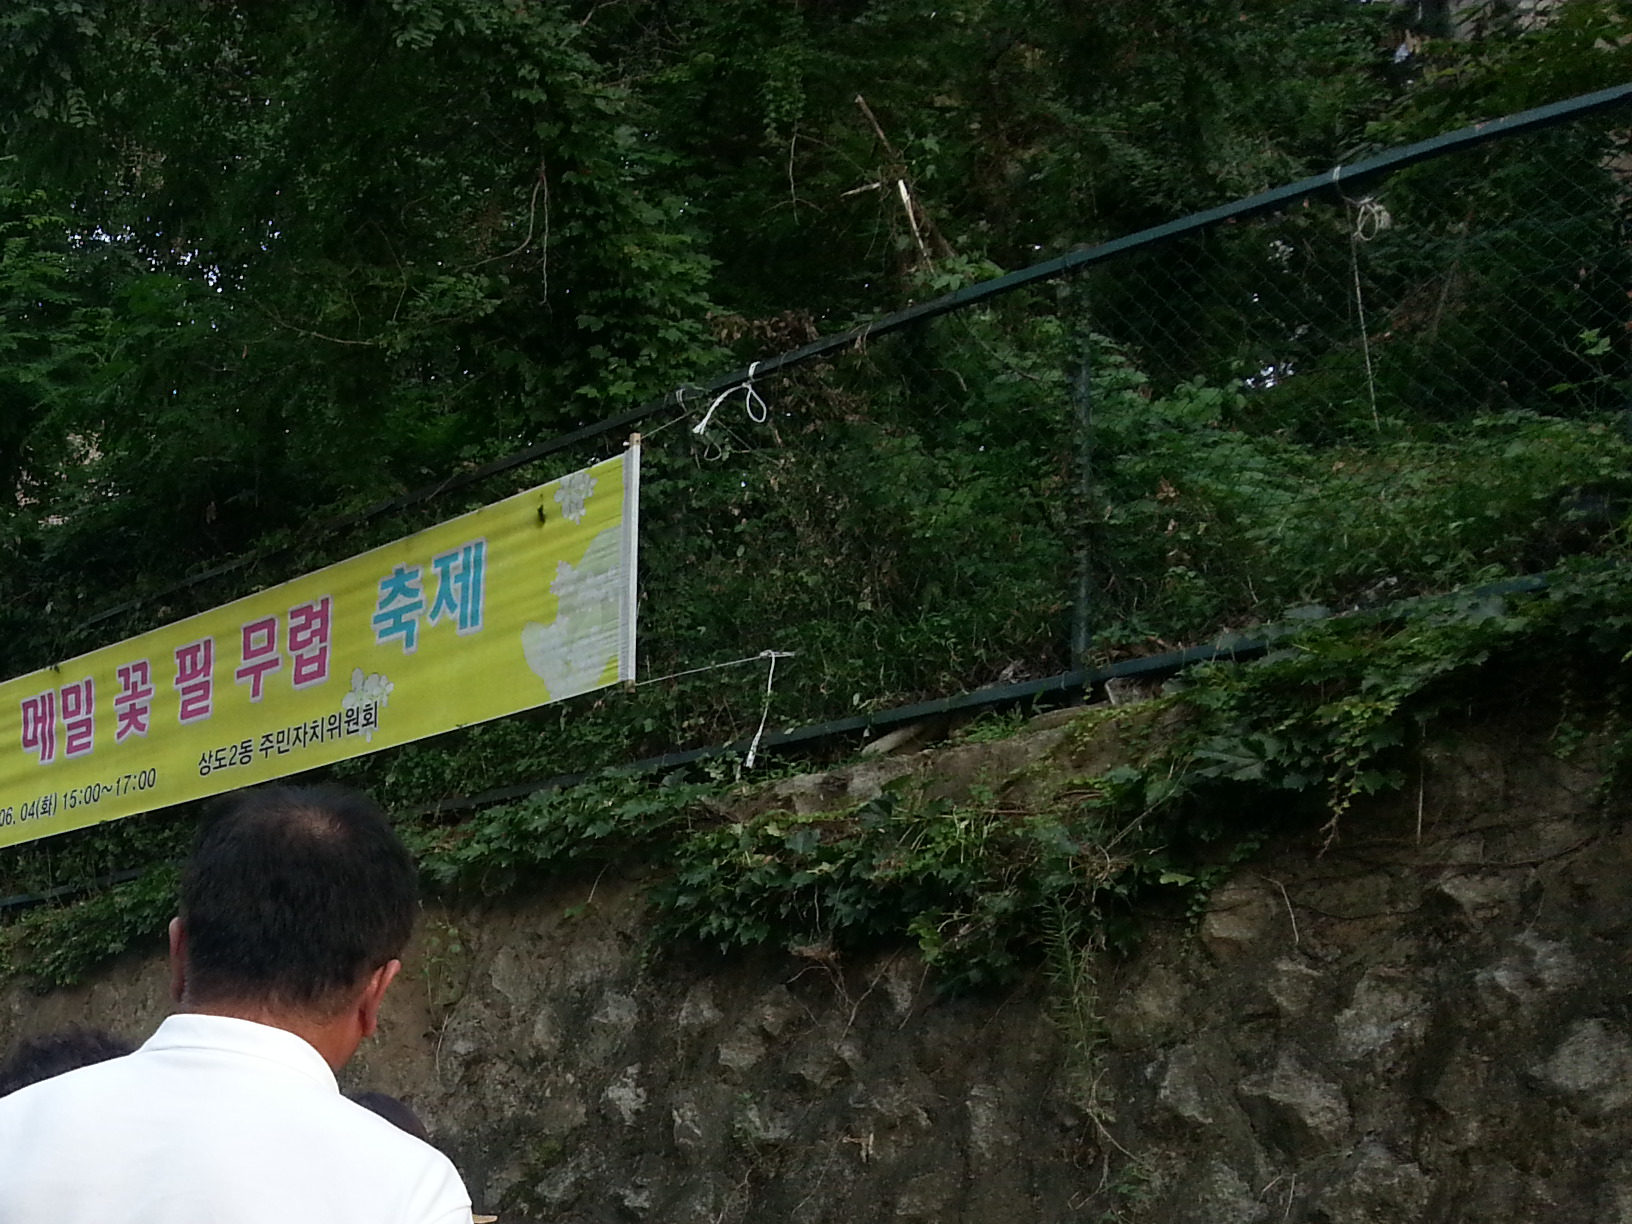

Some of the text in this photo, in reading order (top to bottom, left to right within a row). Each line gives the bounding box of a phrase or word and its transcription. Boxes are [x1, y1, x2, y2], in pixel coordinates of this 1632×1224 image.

[20, 678, 94, 762] 메밀
[113, 660, 155, 741] 꽃
[173, 637, 213, 722] 필
[235, 596, 331, 699] 무렵
[372, 540, 486, 650] 축제
[198, 700, 380, 777] 상도2동 주민자치위원회
[62, 767, 157, 811] 15:00~17:00
